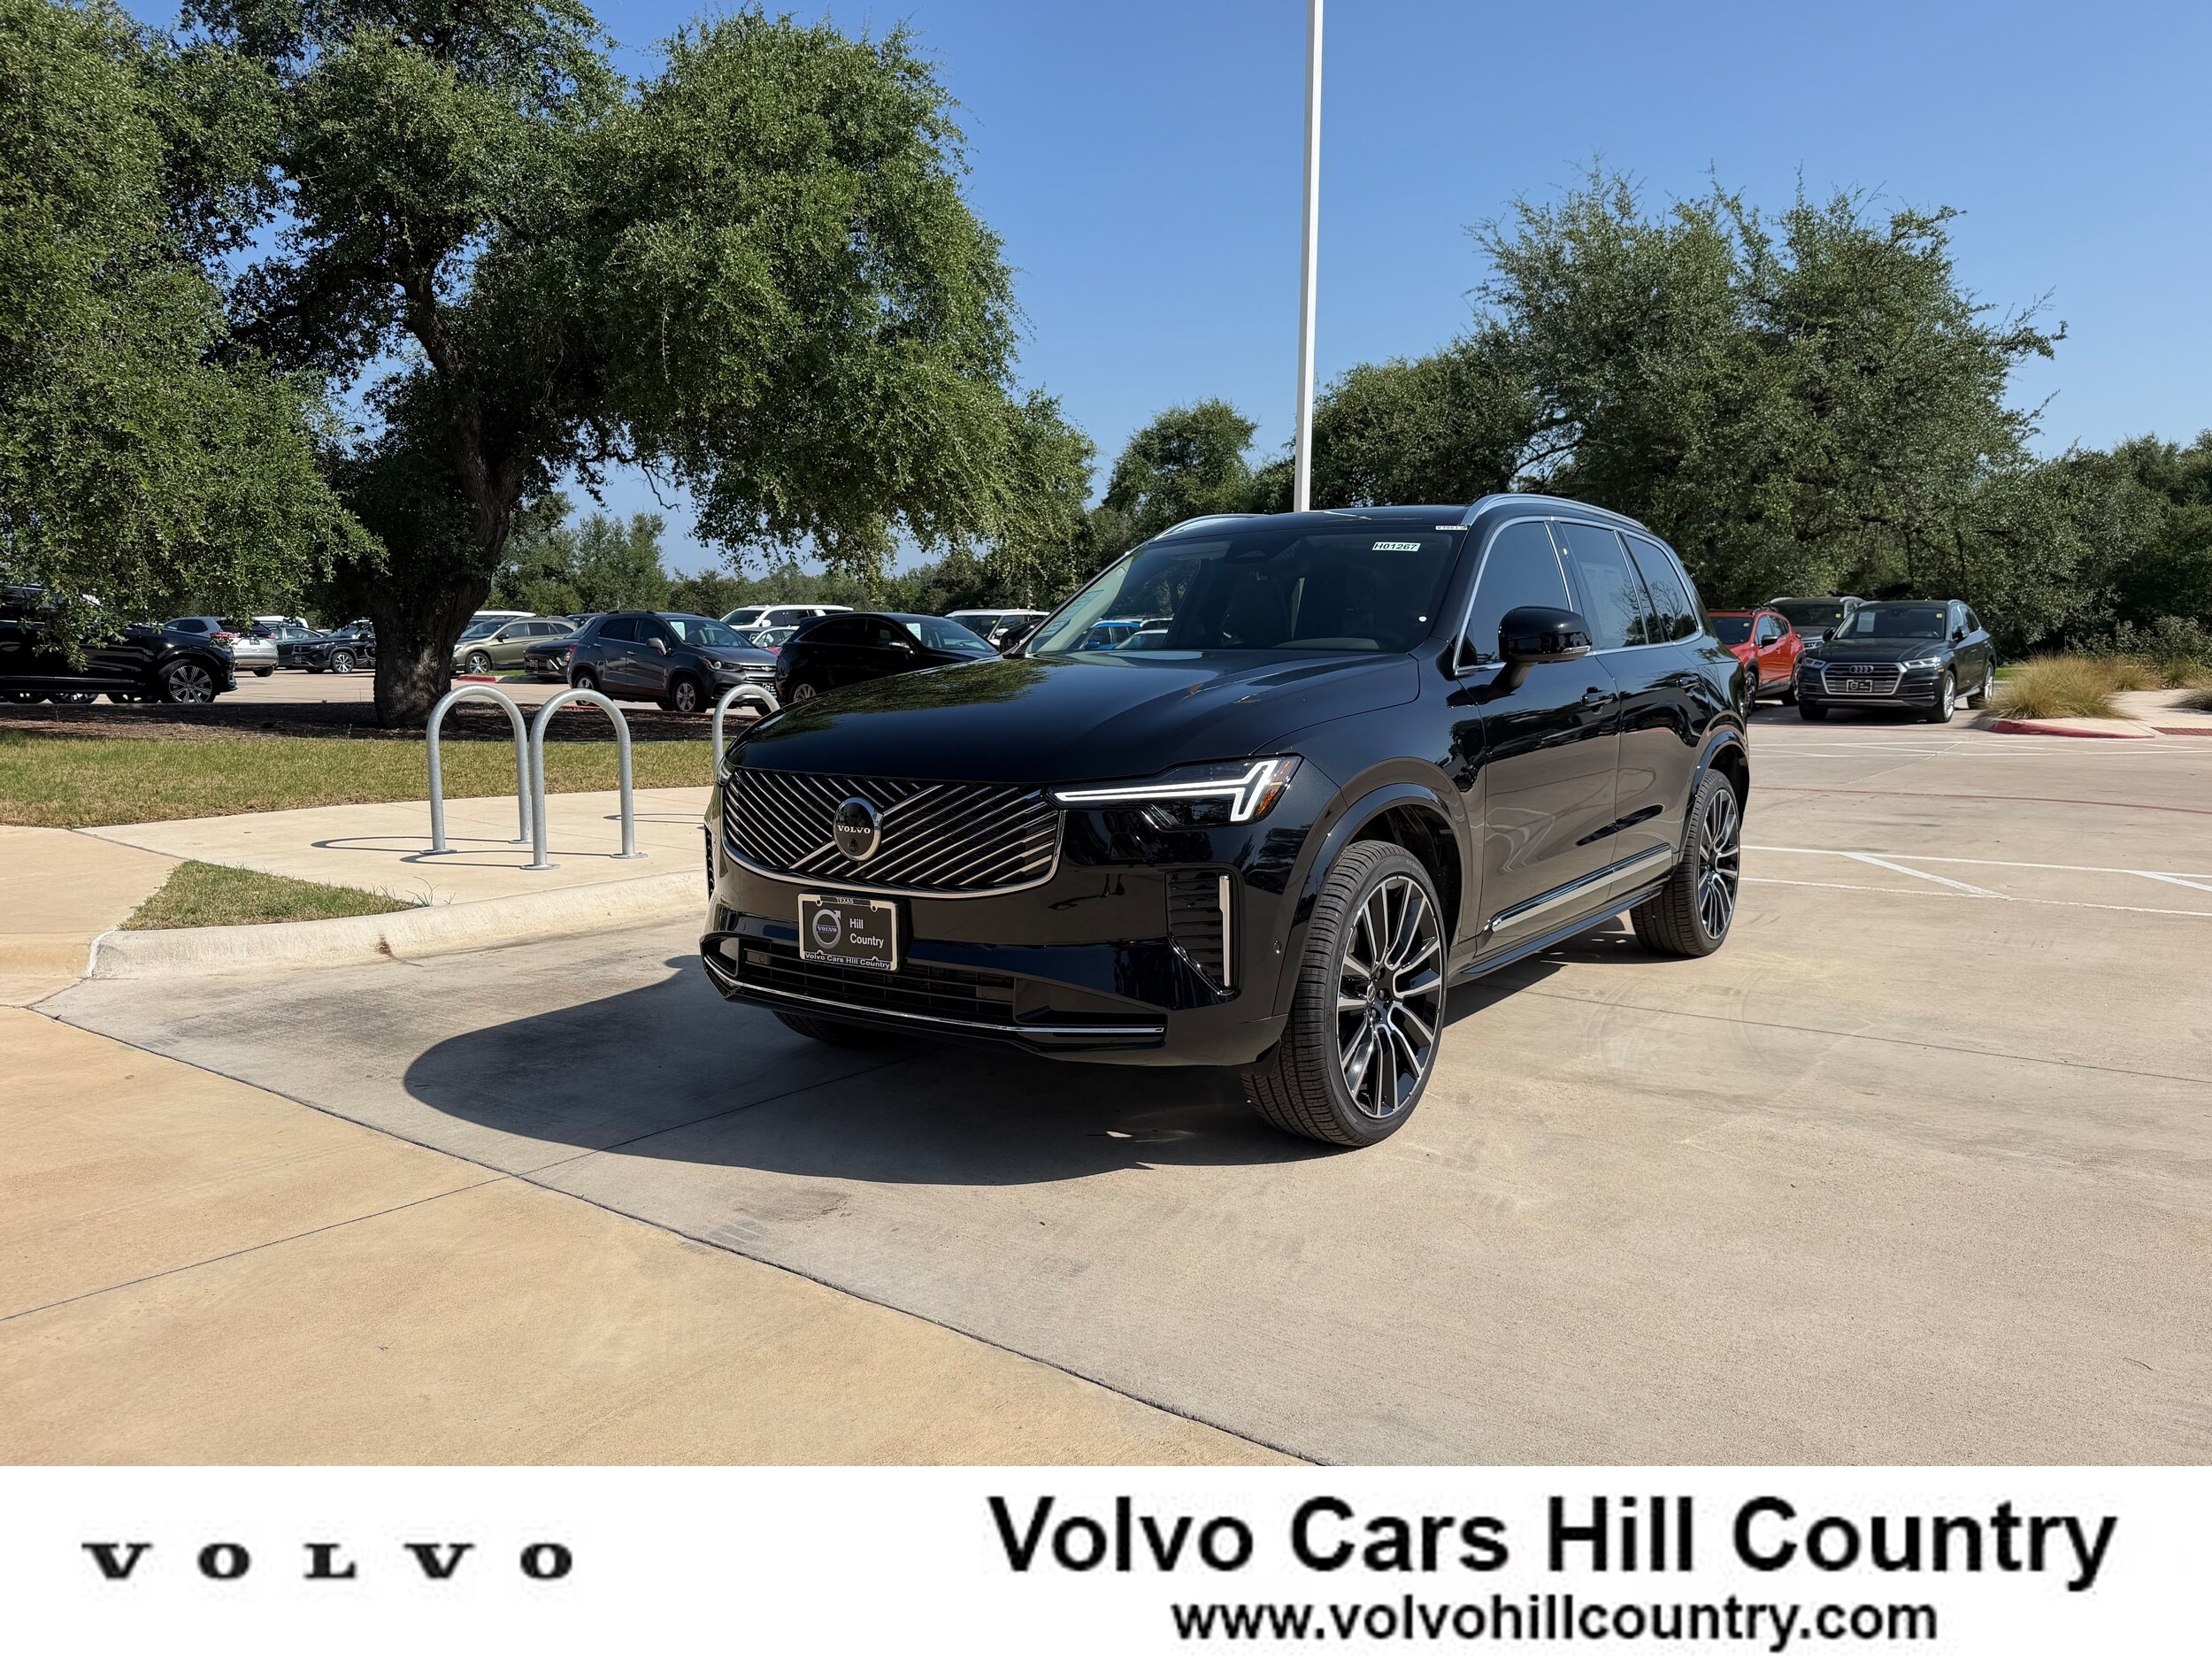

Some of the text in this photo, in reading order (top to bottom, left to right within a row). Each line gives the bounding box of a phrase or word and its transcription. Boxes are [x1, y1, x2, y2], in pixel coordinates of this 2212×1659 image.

[1373, 541, 1417, 550] H01267
[837, 825, 872, 834] VOLVO
[849, 918, 864, 929] Hill
[849, 933, 884, 949] Country
[805, 952, 826, 961] Volvo
[860, 959, 890, 970] Country
